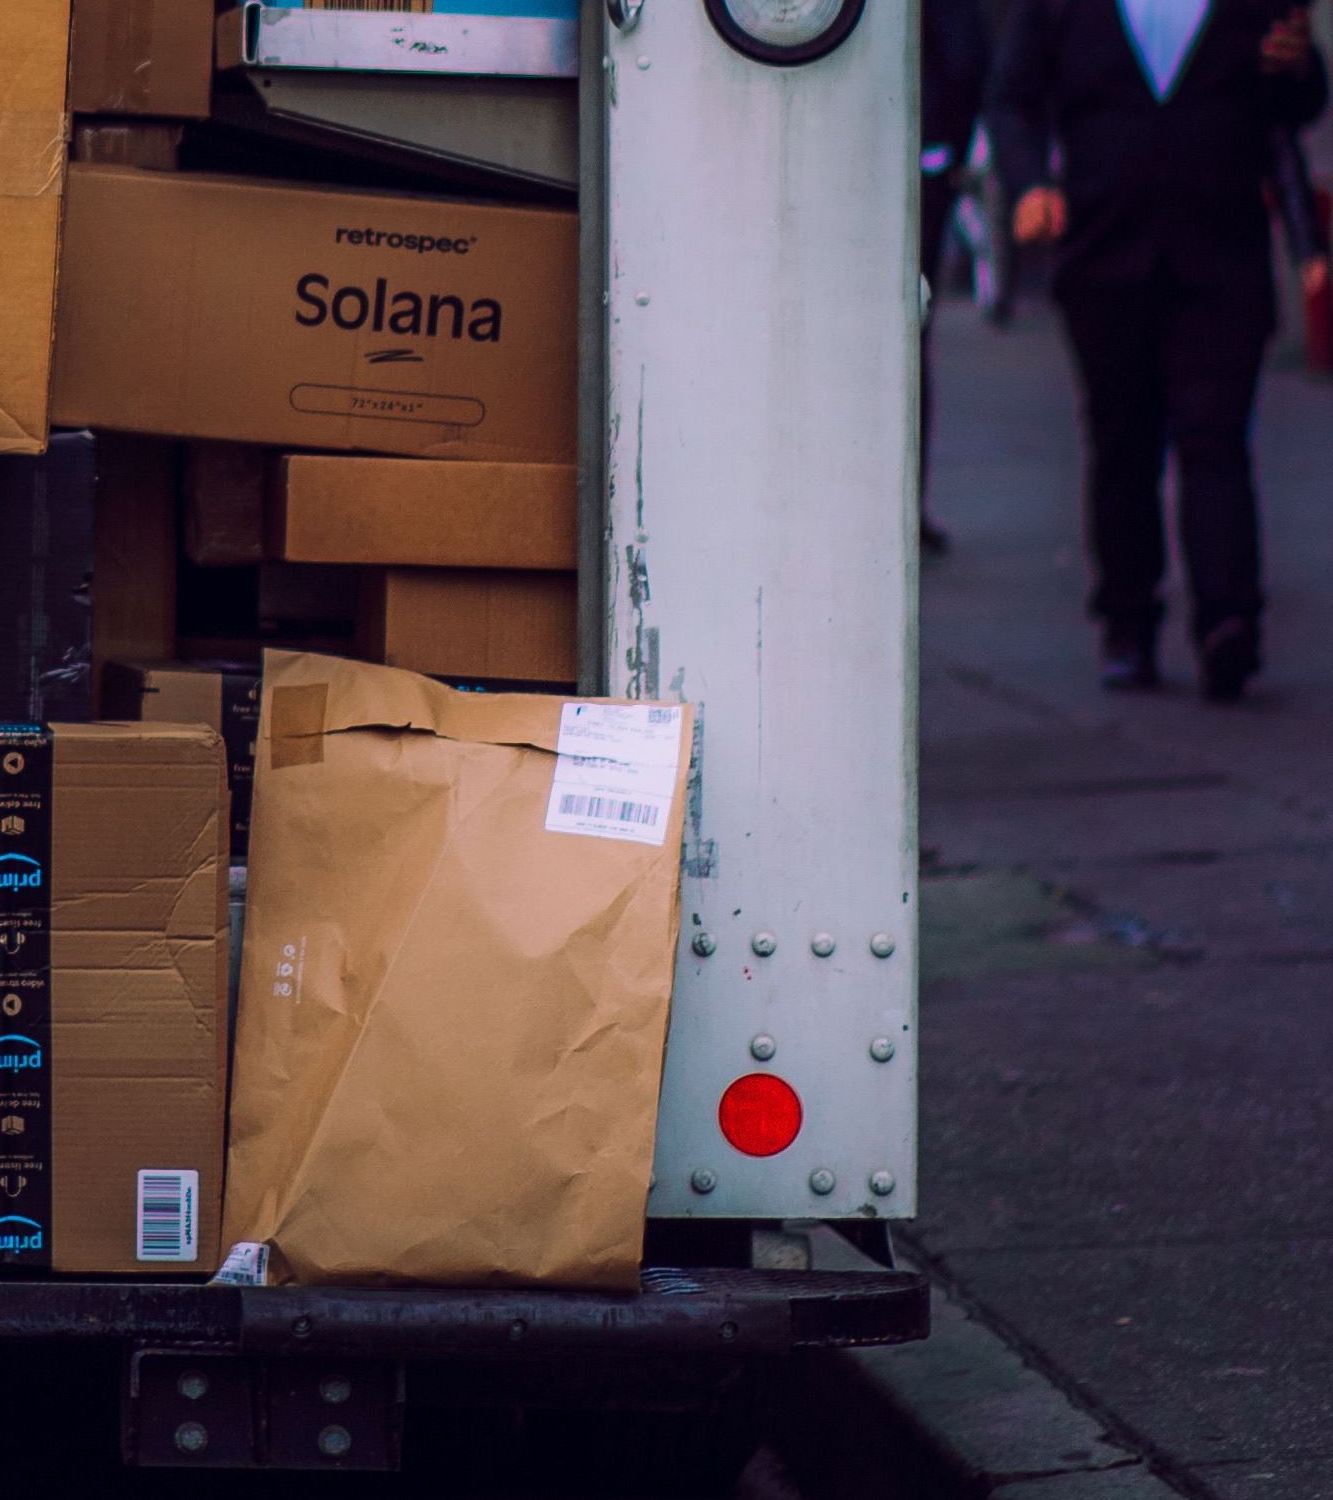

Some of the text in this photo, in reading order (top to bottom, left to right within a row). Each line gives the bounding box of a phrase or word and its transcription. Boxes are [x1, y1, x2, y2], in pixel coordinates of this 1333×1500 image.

[335, 227, 471, 254] retrospec
[294, 272, 503, 343] Solana
[22, 799, 42, 809] free
[23, 918, 43, 928] free
[21, 978, 45, 989] video
[21, 1099, 41, 1109] free
[23, 1161, 43, 1170] free
